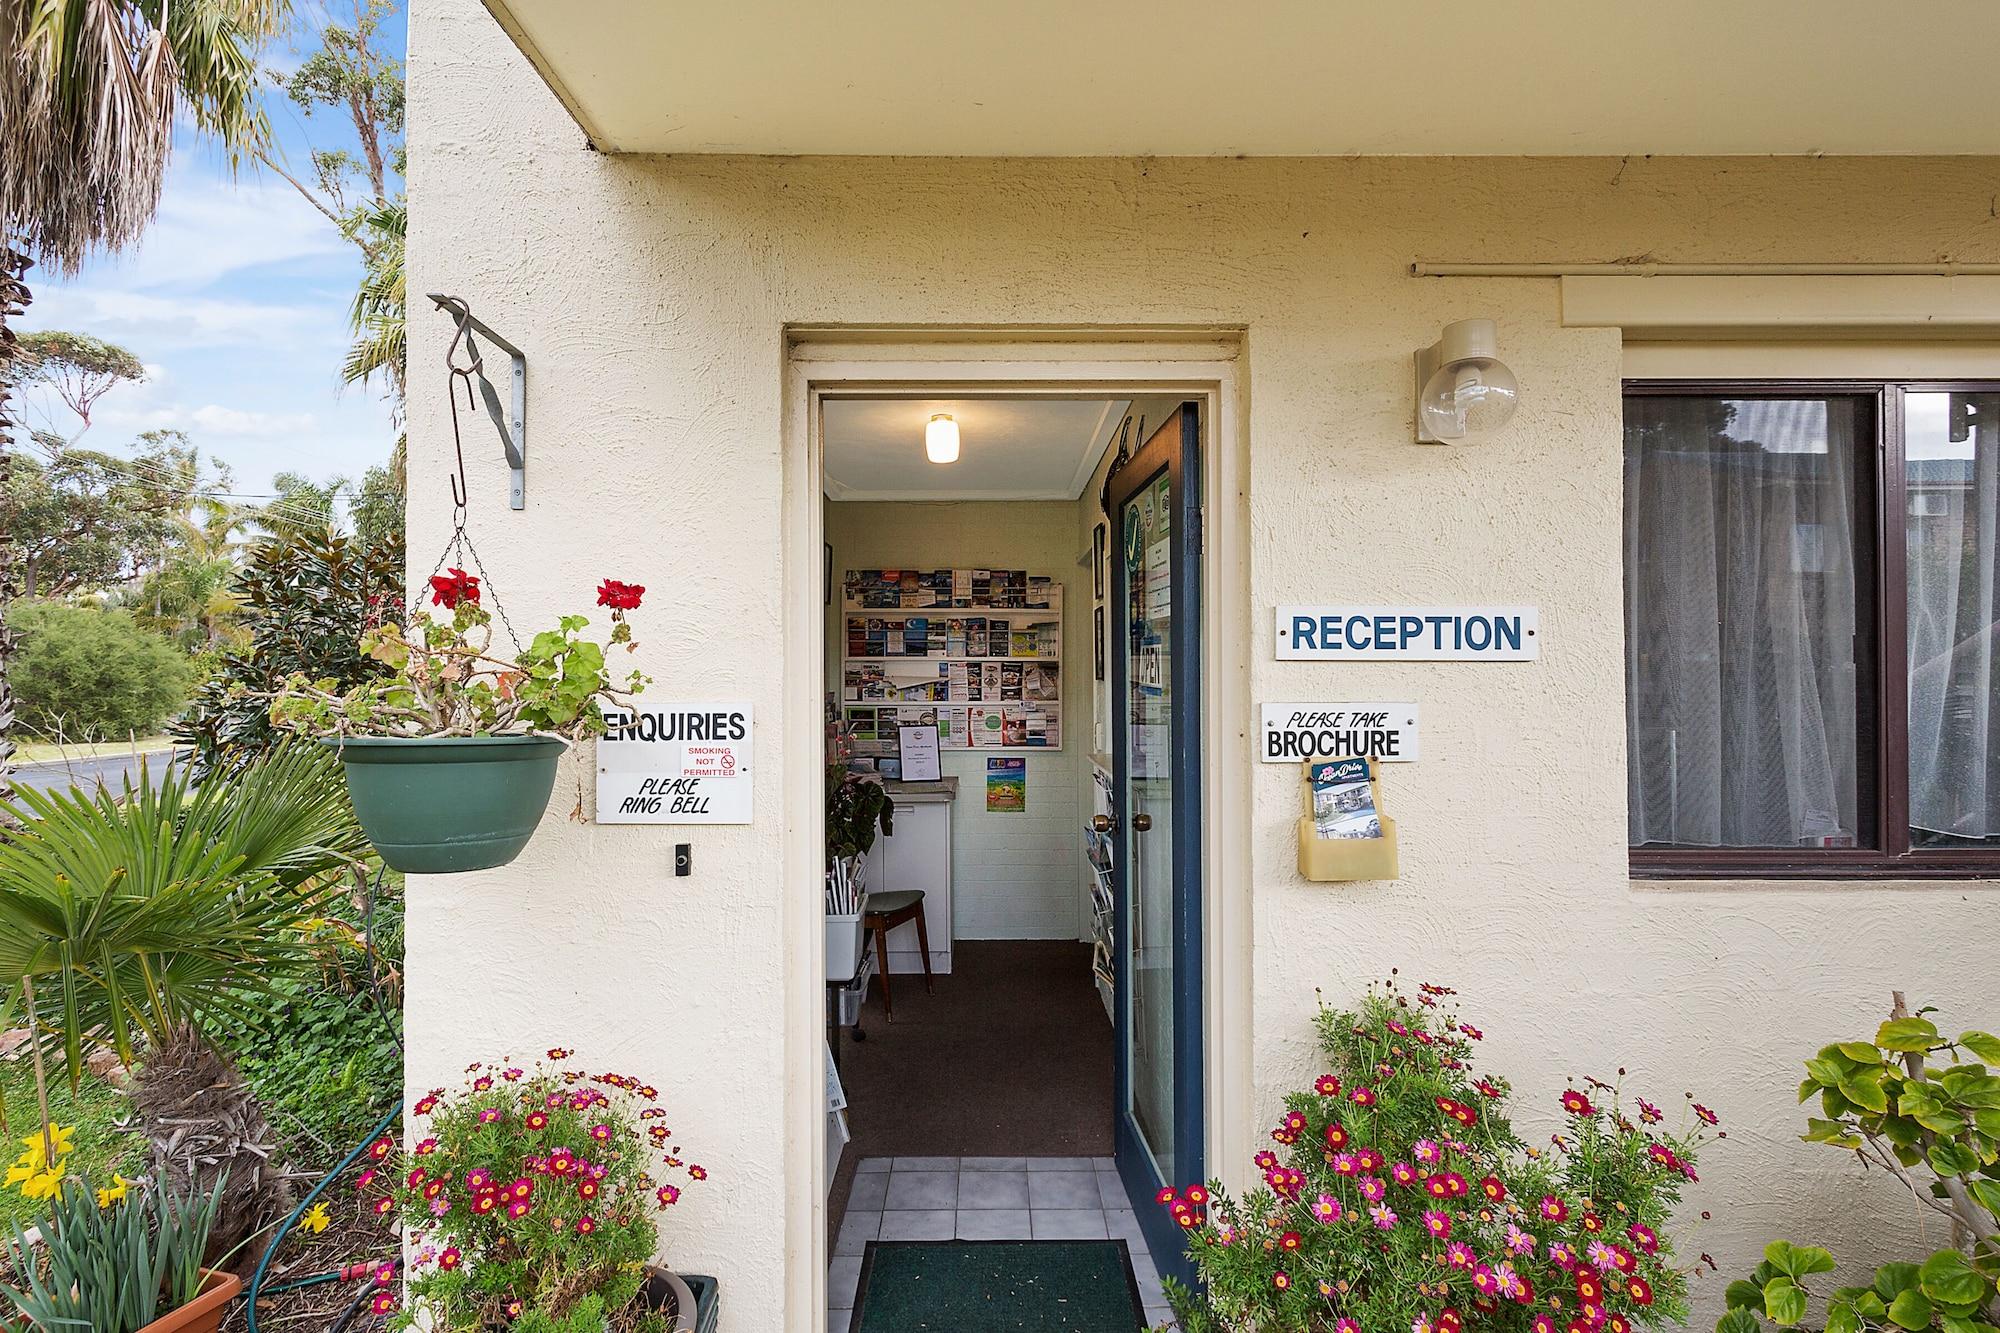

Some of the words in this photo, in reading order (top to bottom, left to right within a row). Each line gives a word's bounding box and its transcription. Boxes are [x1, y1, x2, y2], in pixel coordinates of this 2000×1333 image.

[1292, 615, 1521, 651] RECEPTION
[603, 712, 745, 743] ENQUIRIES
[1286, 711, 1345, 728] PLEASE
[1350, 712, 1389, 728] TAKE
[688, 747, 731, 755] SMOKING
[1268, 730, 1399, 757] BROCHURE
[683, 768, 735, 776] PERMITTED
[639, 778, 700, 795] PLEASE
[619, 796, 662, 814] RING
[670, 796, 710, 814] BELL
